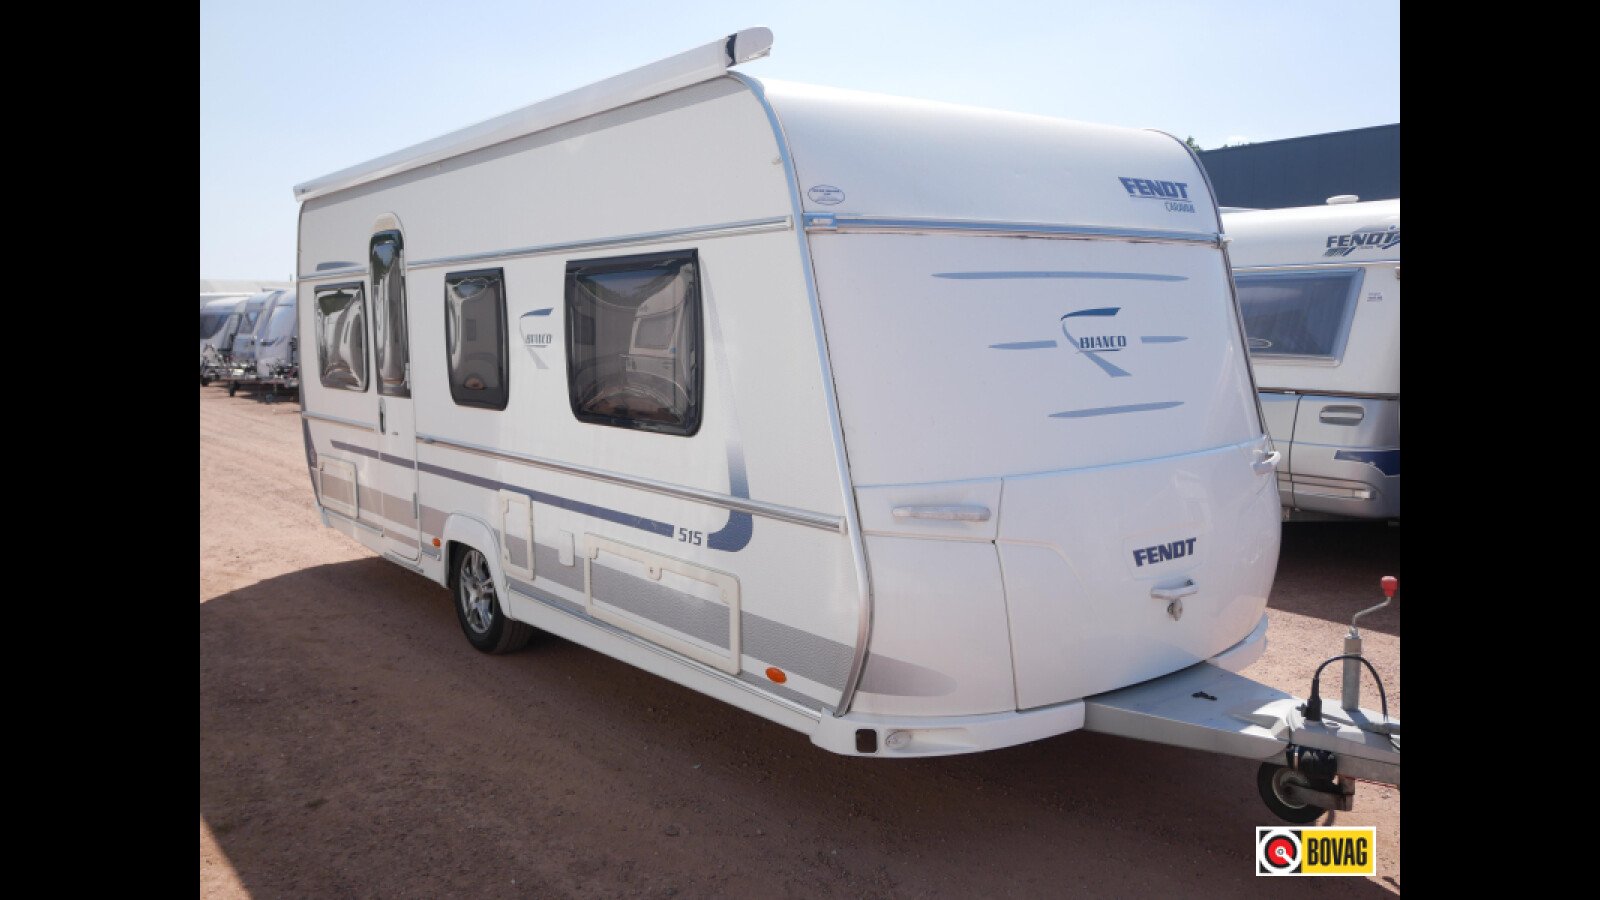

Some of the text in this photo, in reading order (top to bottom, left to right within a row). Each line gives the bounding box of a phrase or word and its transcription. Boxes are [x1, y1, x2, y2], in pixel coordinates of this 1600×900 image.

[1118, 176, 1188, 198] FENDT
[1326, 231, 1397, 248] FENDT
[1080, 335, 1127, 349] BIANCO
[678, 527, 702, 546] 515
[1133, 537, 1197, 567] FENDT
